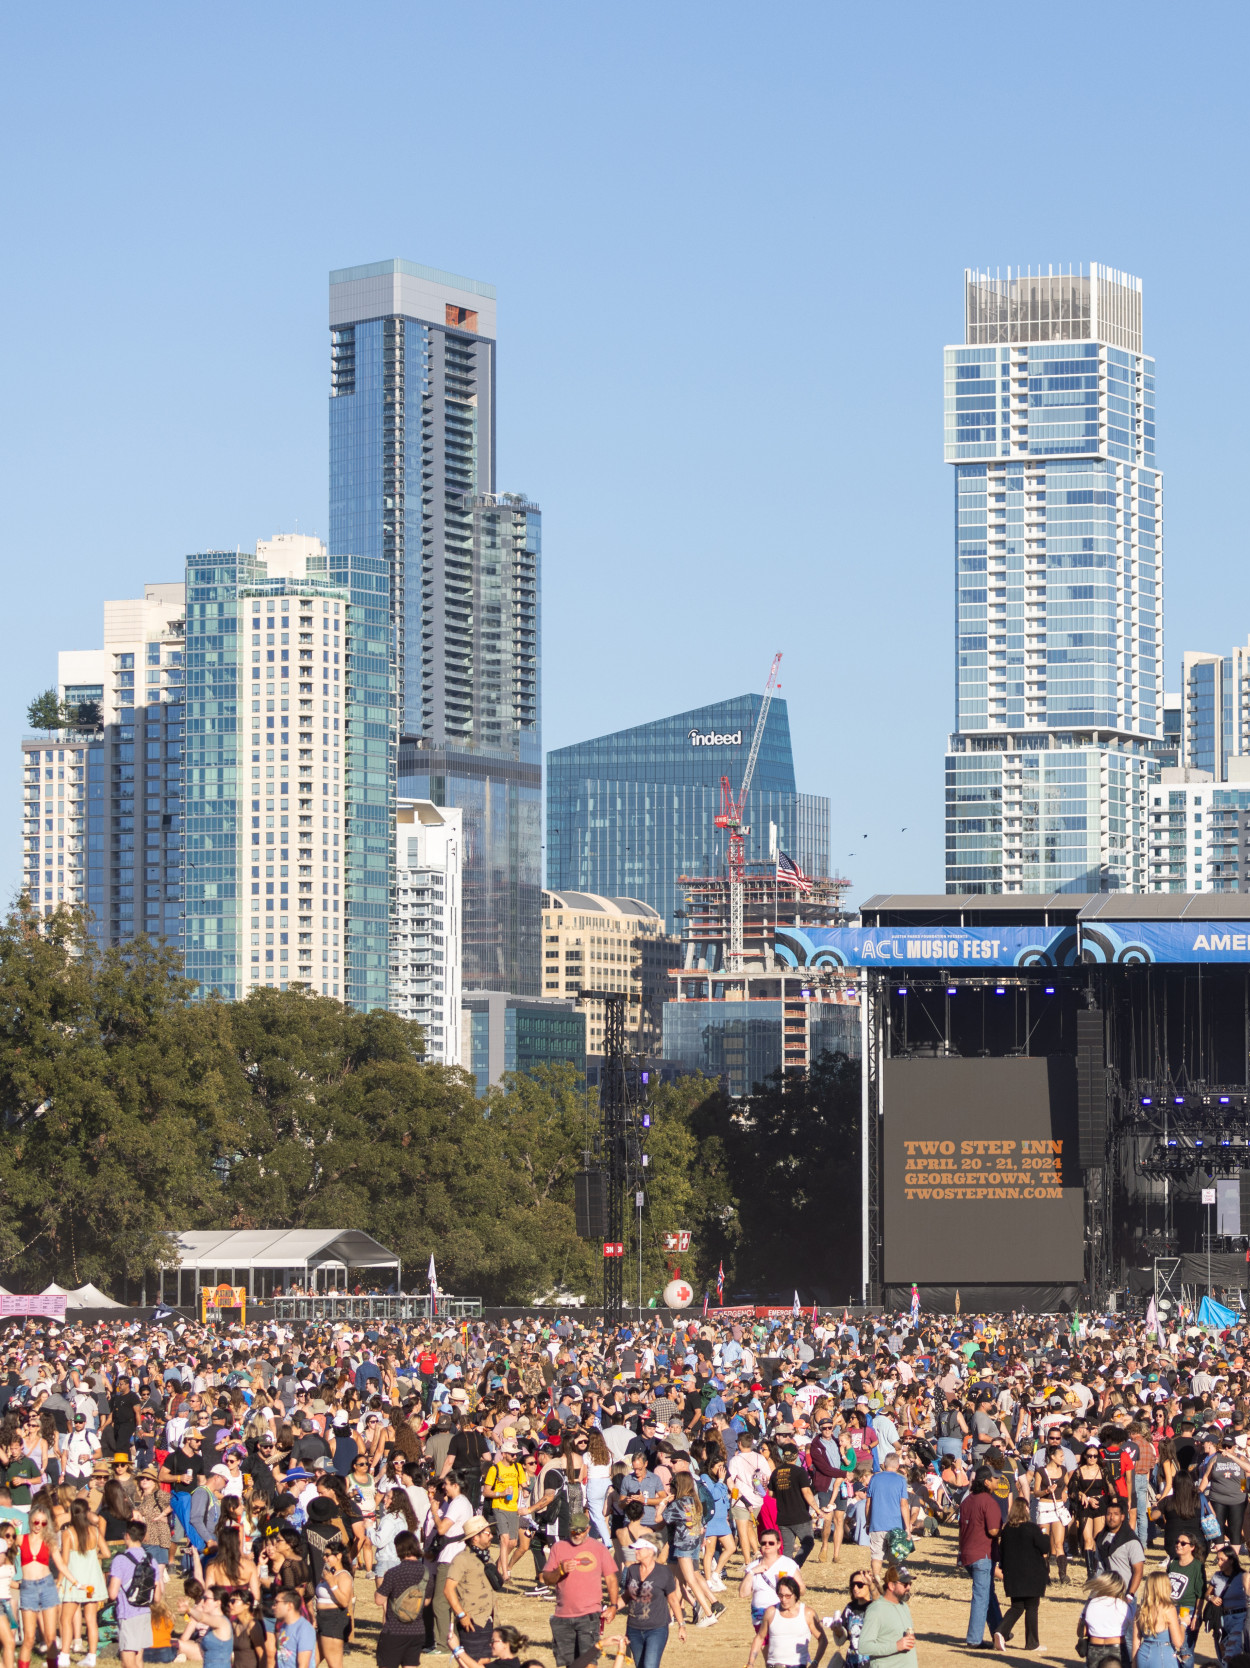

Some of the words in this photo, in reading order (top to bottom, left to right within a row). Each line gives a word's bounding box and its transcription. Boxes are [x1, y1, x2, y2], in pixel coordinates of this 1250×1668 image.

[688, 730, 742, 746] indeed
[861, 940, 904, 959] ACL
[907, 940, 959, 959] MUSIC
[963, 940, 1001, 958] FEST
[904, 1141, 956, 1155] TWO
[961, 1140, 1017, 1155] STEP
[1021, 1140, 1064, 1154] INN
[905, 1158, 958, 1170] APRIL
[961, 1158, 982, 1170] 20
[996, 1158, 1018, 1171] 21,
[1021, 1157, 1063, 1169] 2024
[904, 1172, 1035, 1186] GEORGETOWN,
[1039, 1172, 1063, 1184] TX
[904, 1187, 1063, 1200] TWOSTEPINN.COM
[605, 1246, 614, 1254] 3N
[713, 1309, 756, 1318] EERGENCY
[768, 1309, 804, 1317] EMERGEY
